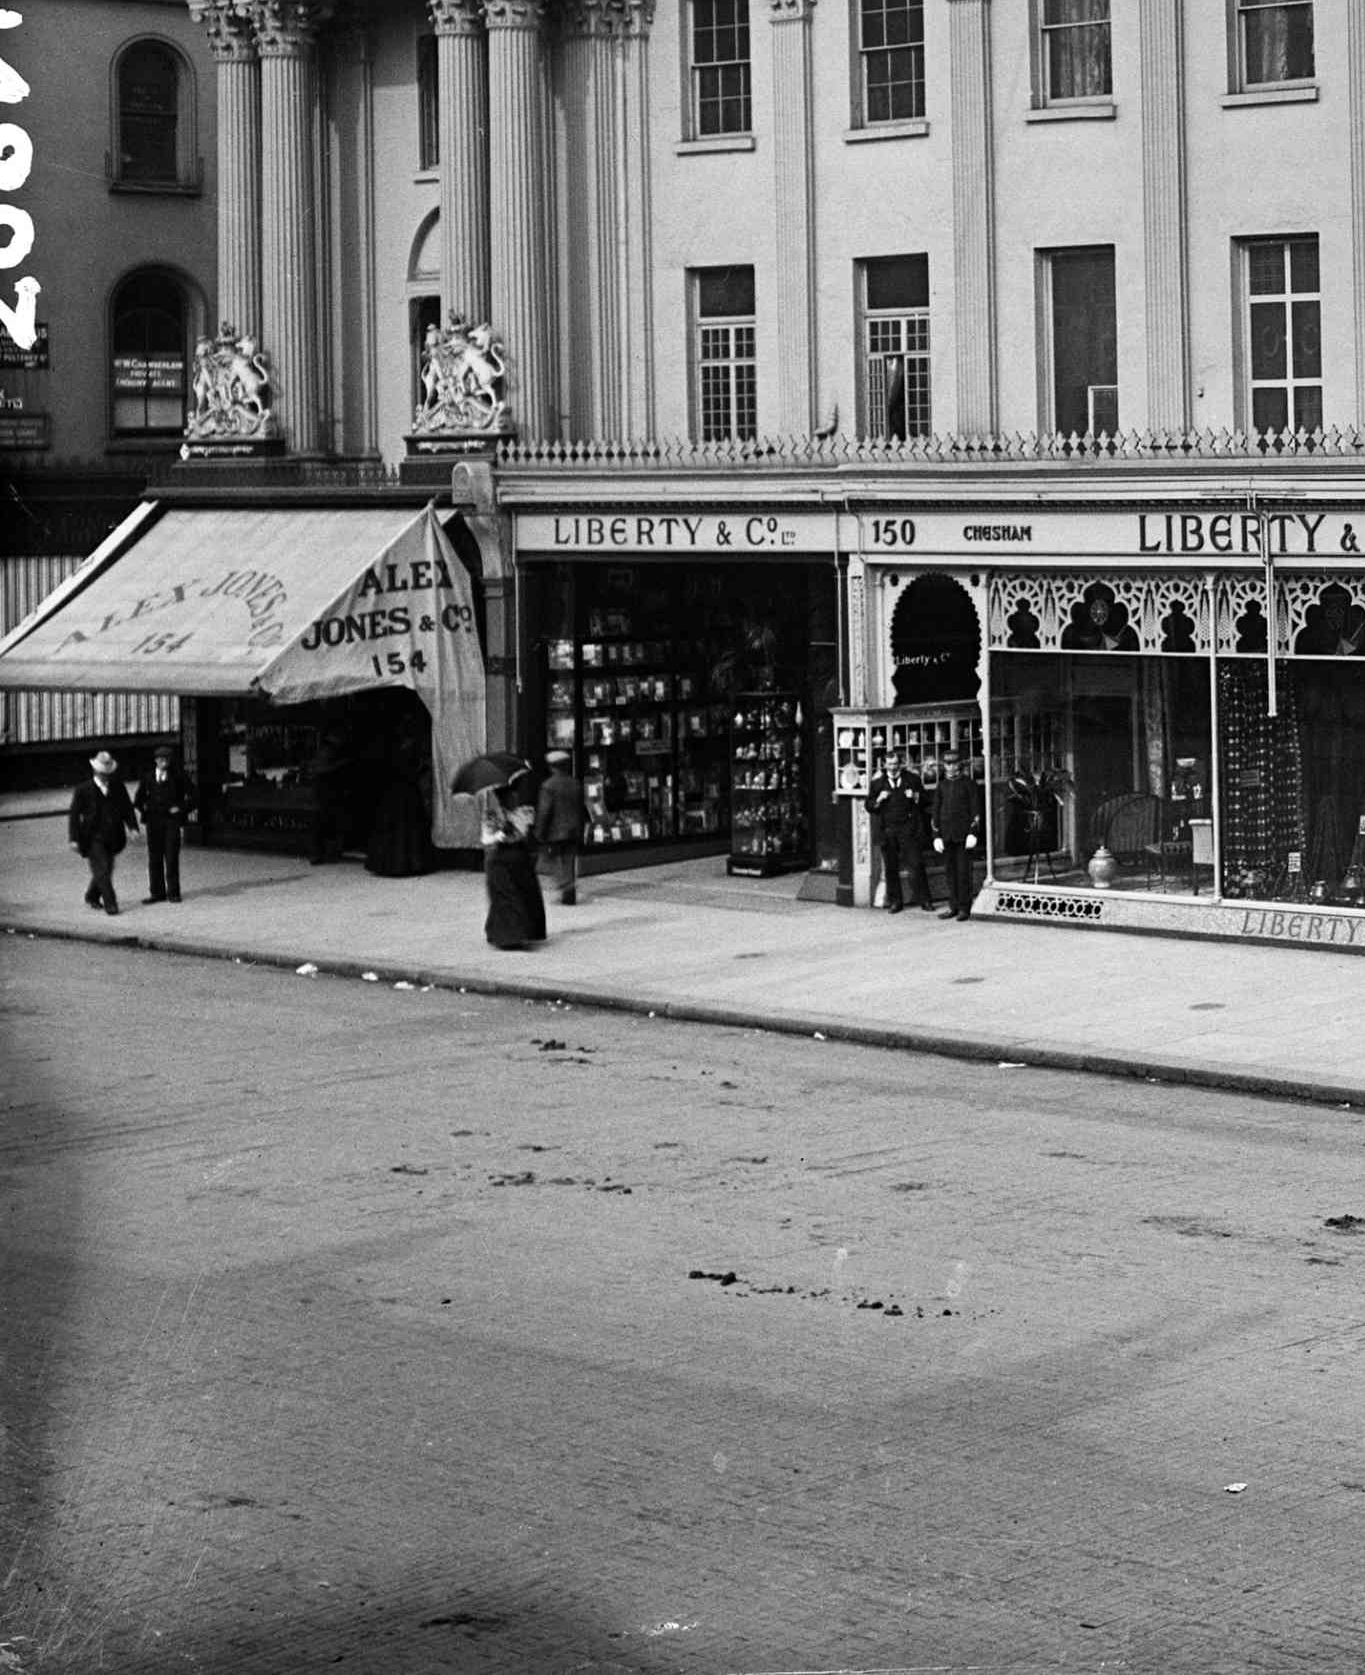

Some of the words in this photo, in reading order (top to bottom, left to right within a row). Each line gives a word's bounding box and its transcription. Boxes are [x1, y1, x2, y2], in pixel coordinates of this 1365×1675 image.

[554, 517, 703, 546] LIBERTY
[716, 520, 732, 546] &
[872, 519, 916, 546] 150
[963, 524, 1032, 542] CHESHAM
[1138, 513, 1327, 554] LIBERTY
[1340, 523, 1360, 552] &
[300, 606, 411, 651] JONES
[418, 614, 435, 633] &
[131, 631, 195, 656] 154
[371, 649, 428, 678] 154
[895, 653, 930, 668] Liberty
[1241, 909, 1363, 945] LIBERTY
